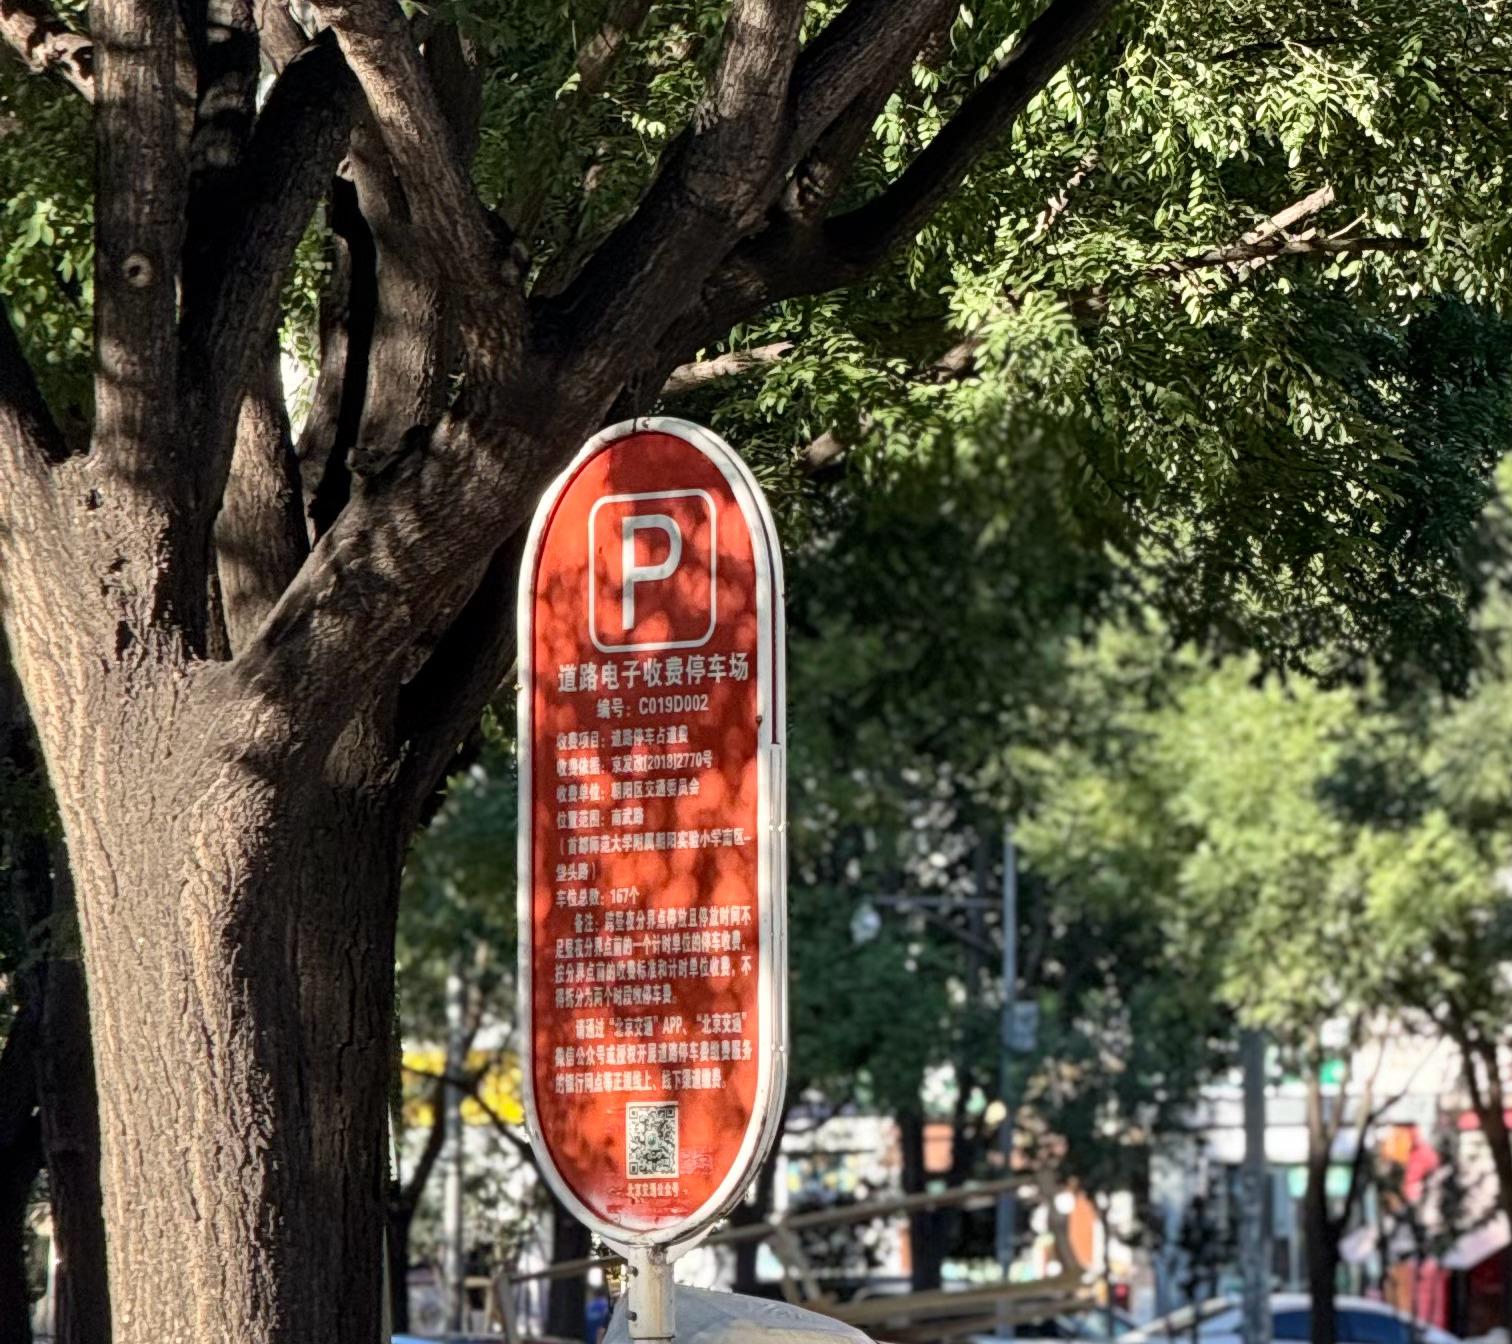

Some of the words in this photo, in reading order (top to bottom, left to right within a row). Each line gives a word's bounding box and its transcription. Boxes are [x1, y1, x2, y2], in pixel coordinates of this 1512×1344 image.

[558, 652, 749, 693] 道路电子收费停车场
